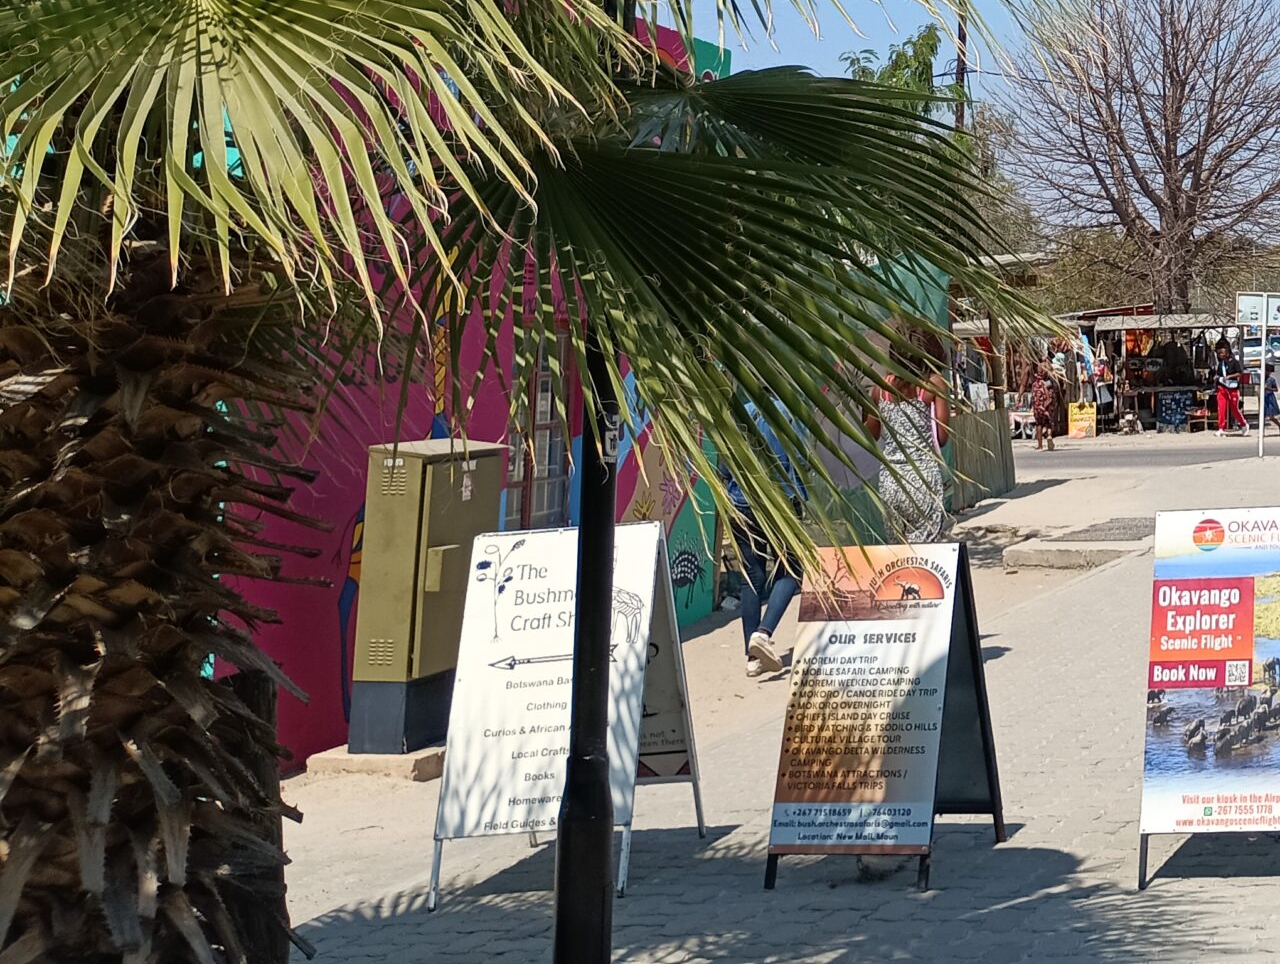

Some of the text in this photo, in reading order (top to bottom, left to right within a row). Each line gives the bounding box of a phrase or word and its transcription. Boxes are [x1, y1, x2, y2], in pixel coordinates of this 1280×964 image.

[1228, 533, 1268, 544] SCENIC
[516, 563, 548, 580] The
[885, 556, 929, 573] ORCHESTRA
[930, 560, 953, 589] SAFARIS
[514, 587, 576, 606] Bushm
[1158, 586, 1240, 608] Okavango
[510, 612, 553, 633] Craft
[1166, 610, 1237, 635] Explorer
[828, 632, 917, 645] OUR SERVICES
[1160, 634, 1233, 651] Scenic Flight
[803, 656, 879, 665] MOREMI DAY TRIP
[801, 666, 910, 676] MOBILE SAFARI CAMPING
[1153, 665, 1217, 682] Book Now
[505, 677, 554, 690] Botswana
[800, 677, 921, 687] MOREMI WEEKEND CAMPING
[798, 688, 938, 699] MOKORO / CANOE RIDE DAY TRIP
[526, 700, 568, 712] Clothing
[797, 700, 892, 710] MOKORO OVERNIGHT
[796, 711, 911, 721] CHIEFS ISLAND DAY CRUISE
[483, 723, 566, 739] Curios & African
[794, 722, 938, 733] BIRD WATCHING & TSODILO HILLS
[792, 735, 902, 744] CULTURAL VILLAGE TOUR
[511, 749, 539, 760] Local
[791, 745, 926, 756] OKAVANGO DELTA WILDERNESS
[790, 759, 832, 768] CAMPING
[524, 771, 555, 783] Books
[788, 769, 908, 779] BOTSWANA ATTRACTIONS /
[787, 781, 884, 791] VICTORIA FALLS TRIPS
[1181, 795, 1200, 805] Visit
[1202, 796, 1215, 805] our
[1216, 794, 1238, 804] kiosk
[1240, 794, 1248, 804] in
[1249, 794, 1263, 803] the
[792, 808, 811, 817] +267
[872, 808, 912, 817] 76403120
[1234, 805, 1255, 815] 7555
[1256, 804, 1273, 815] 1778
[484, 817, 557, 832] Field Guides &
[773, 820, 797, 828] Email:
[798, 832, 833, 841] Location:
[836, 832, 851, 841] New
[876, 832, 899, 841] Maun
